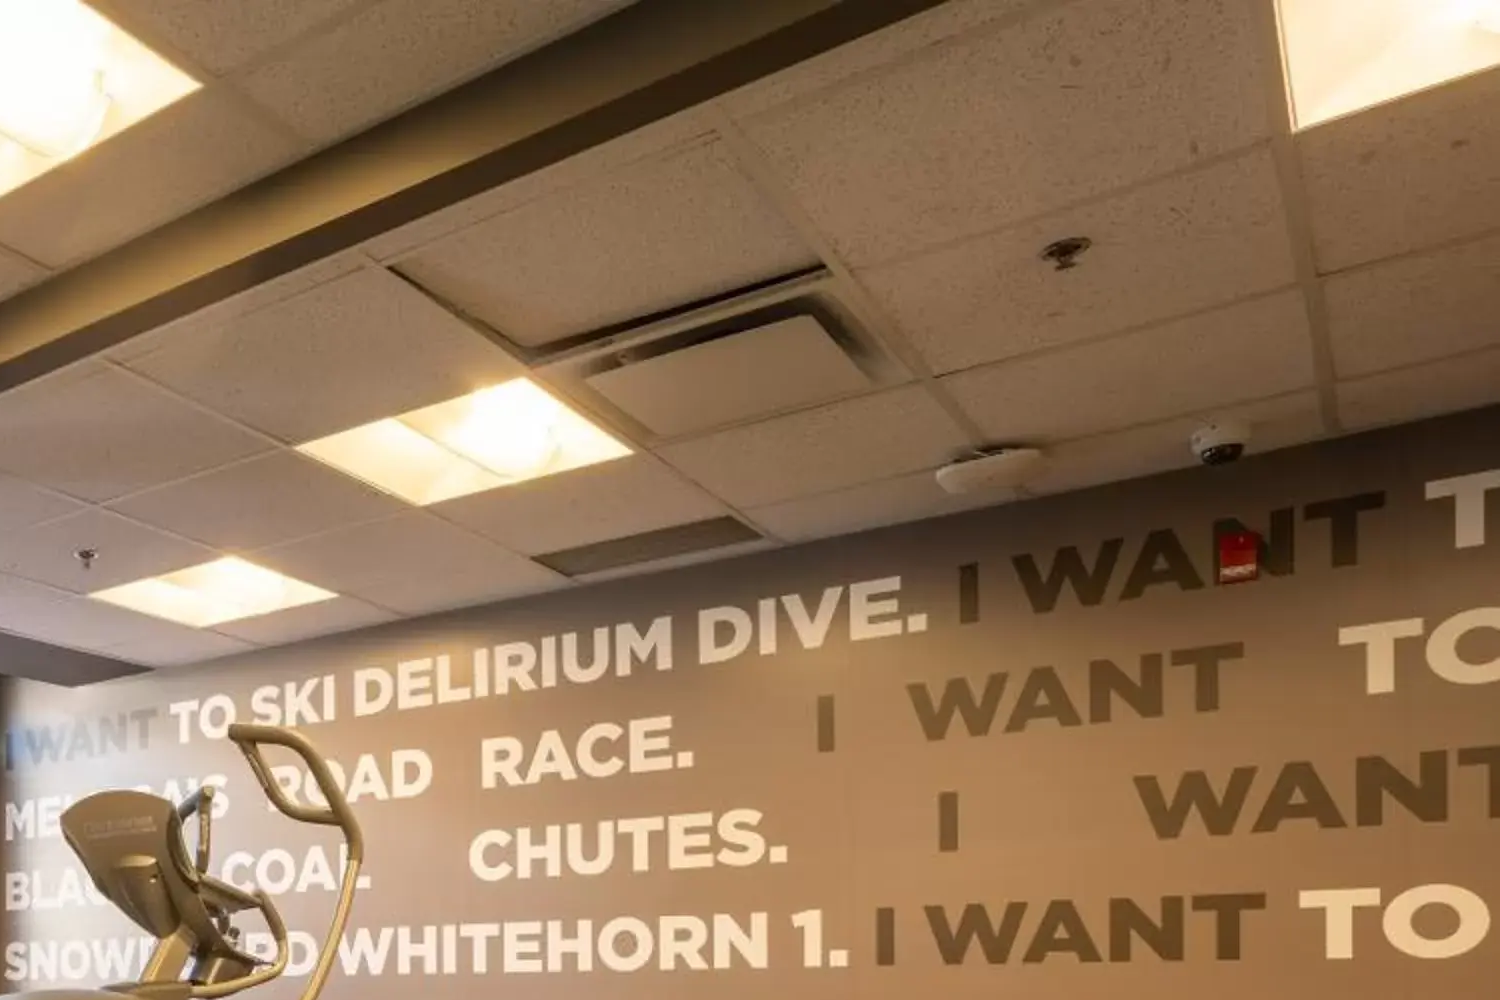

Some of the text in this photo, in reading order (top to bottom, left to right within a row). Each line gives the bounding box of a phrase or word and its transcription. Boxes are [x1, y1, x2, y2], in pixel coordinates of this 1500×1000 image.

[26, 709, 158, 766] WANT
[169, 694, 237, 745] TO
[251, 676, 336, 728] SKI
[354, 616, 673, 718] DELIRIUM
[698, 576, 928, 663] DIVE.
[959, 562, 978, 624] I
[1012, 490, 1387, 615] WANT
[267, 749, 433, 813] ROAD
[481, 716, 695, 790] RACE.
[817, 695, 835, 753] I
[907, 642, 1245, 742] WANT
[1338, 606, 1500, 695] TO
[470, 807, 788, 882] CHUTES.
[938, 792, 959, 852] I
[339, 911, 768, 977] WHITEHORN
[791, 908, 850, 968] 1.
[876, 907, 895, 967] I
[923, 892, 1267, 966] WANT
[1298, 883, 1492, 960] TO
